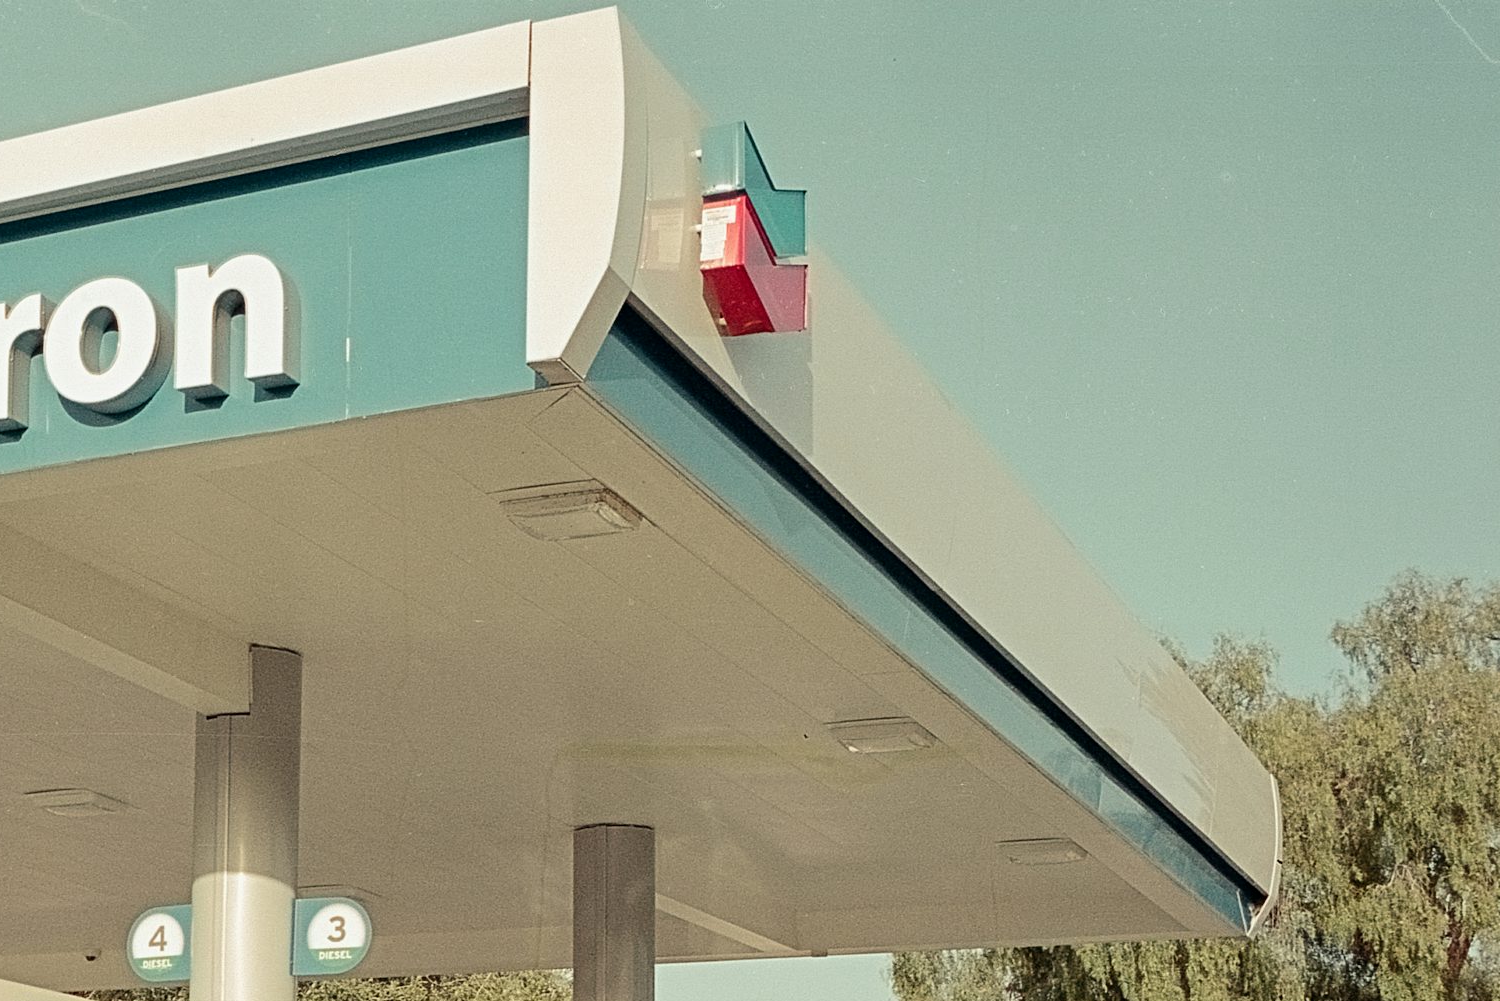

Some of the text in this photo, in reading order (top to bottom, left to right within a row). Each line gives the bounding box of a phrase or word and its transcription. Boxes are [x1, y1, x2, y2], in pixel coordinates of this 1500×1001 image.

[327, 915, 347, 942] 3
[148, 925, 168, 951] 4
[142, 958, 173, 969] DIESEL
[318, 951, 352, 961] DIESEL
